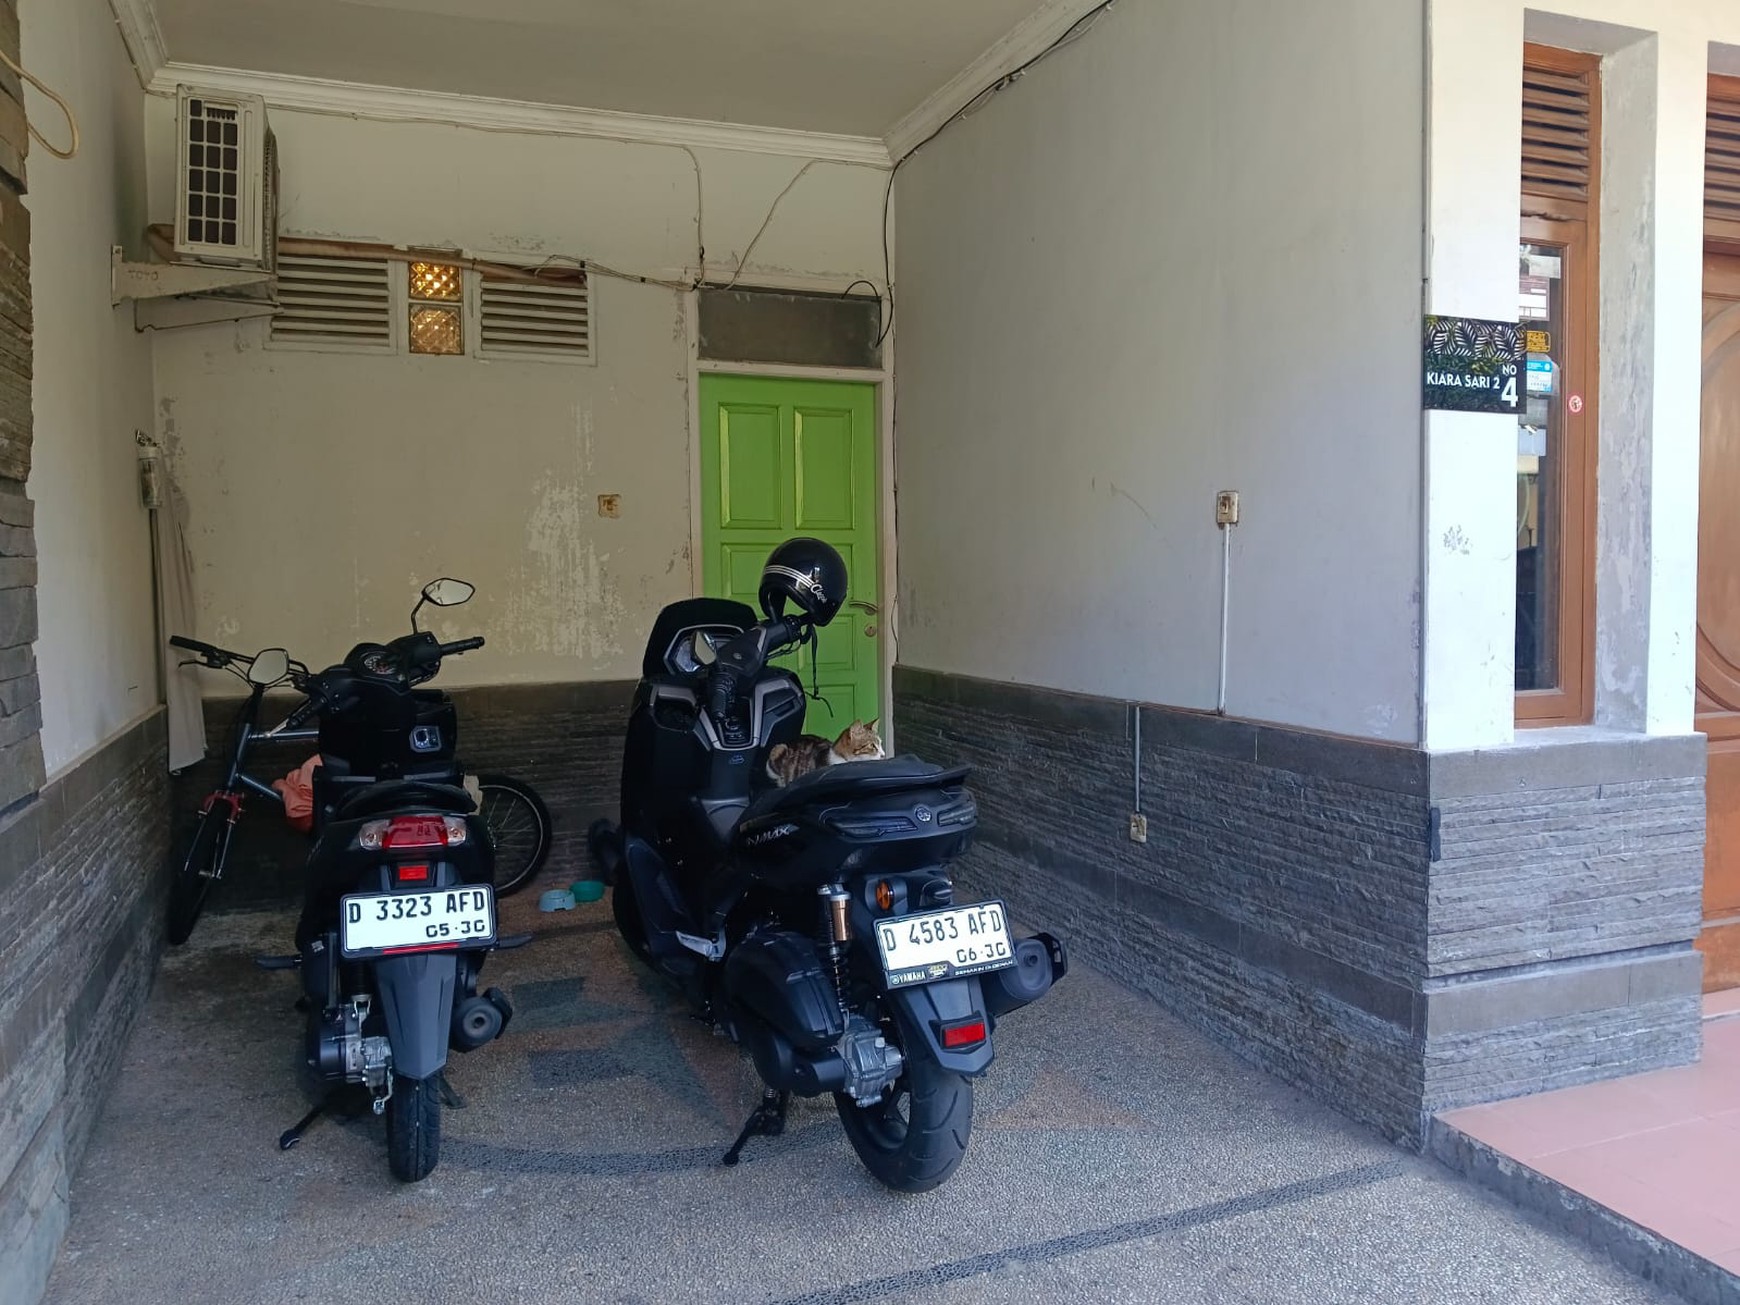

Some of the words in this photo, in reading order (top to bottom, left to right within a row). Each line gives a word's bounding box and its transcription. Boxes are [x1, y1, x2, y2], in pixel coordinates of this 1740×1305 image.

[1427, 372, 1462, 387] KIARA
[1465, 374, 1490, 389] SARI
[1493, 377, 1500, 389] 2
[1502, 364, 1517, 376] NO
[1501, 377, 1519, 408] 4
[349, 902, 361, 924] D
[376, 896, 432, 921] 3323
[446, 891, 485, 914] AFD
[883, 928, 897, 951] D
[909, 916, 959, 945] 4583
[968, 910, 1001, 935] AFD
[900, 971, 926, 983] YAMAHA
